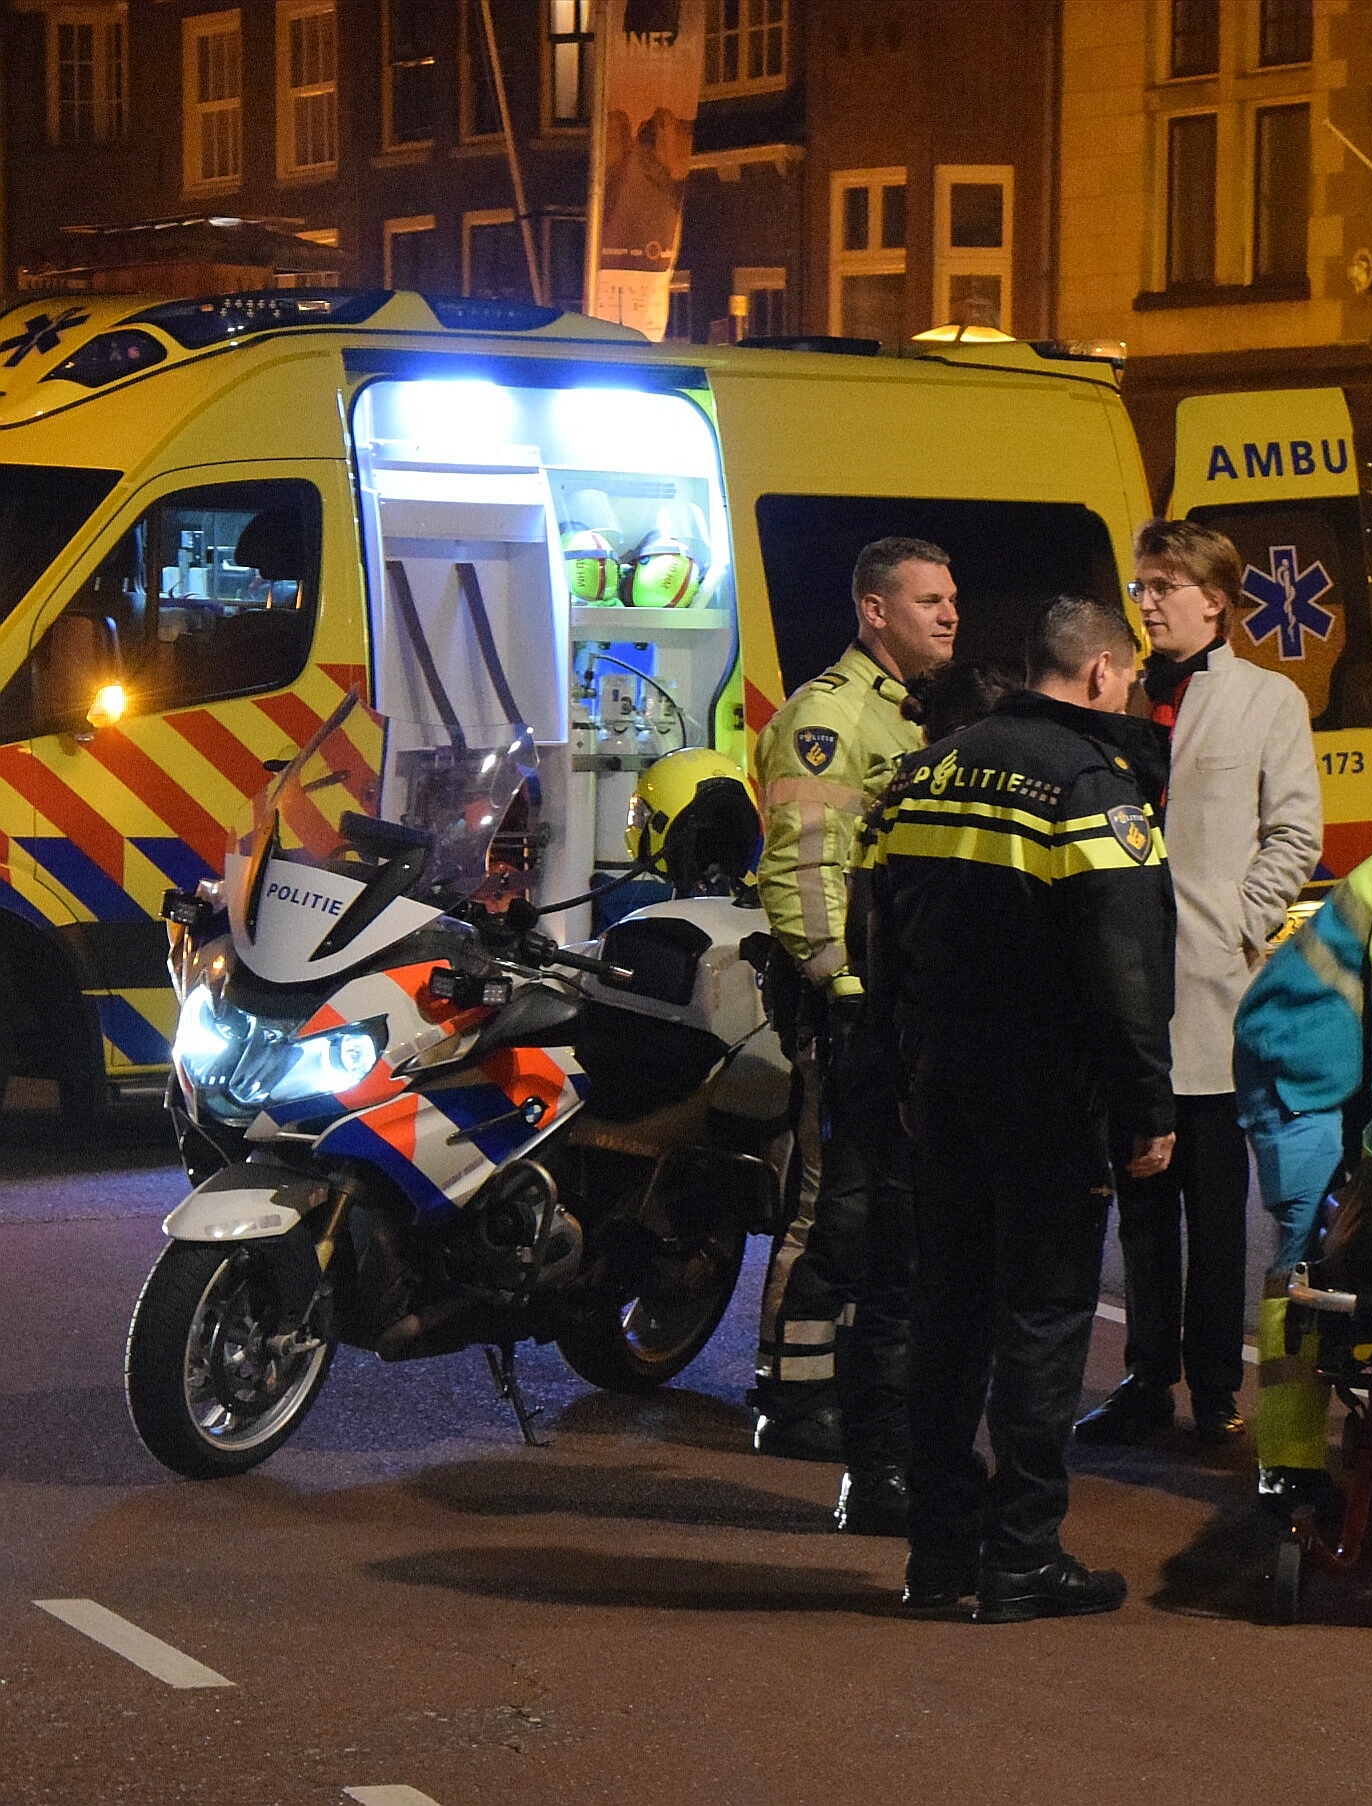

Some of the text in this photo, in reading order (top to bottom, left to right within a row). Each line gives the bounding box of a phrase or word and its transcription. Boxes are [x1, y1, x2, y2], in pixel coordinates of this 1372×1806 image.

[1206, 438, 1348, 481] AMBU
[913, 755, 1026, 795] POLITIE
[1321, 750, 1364, 775] 173
[266, 882, 343, 916] POLITIE
